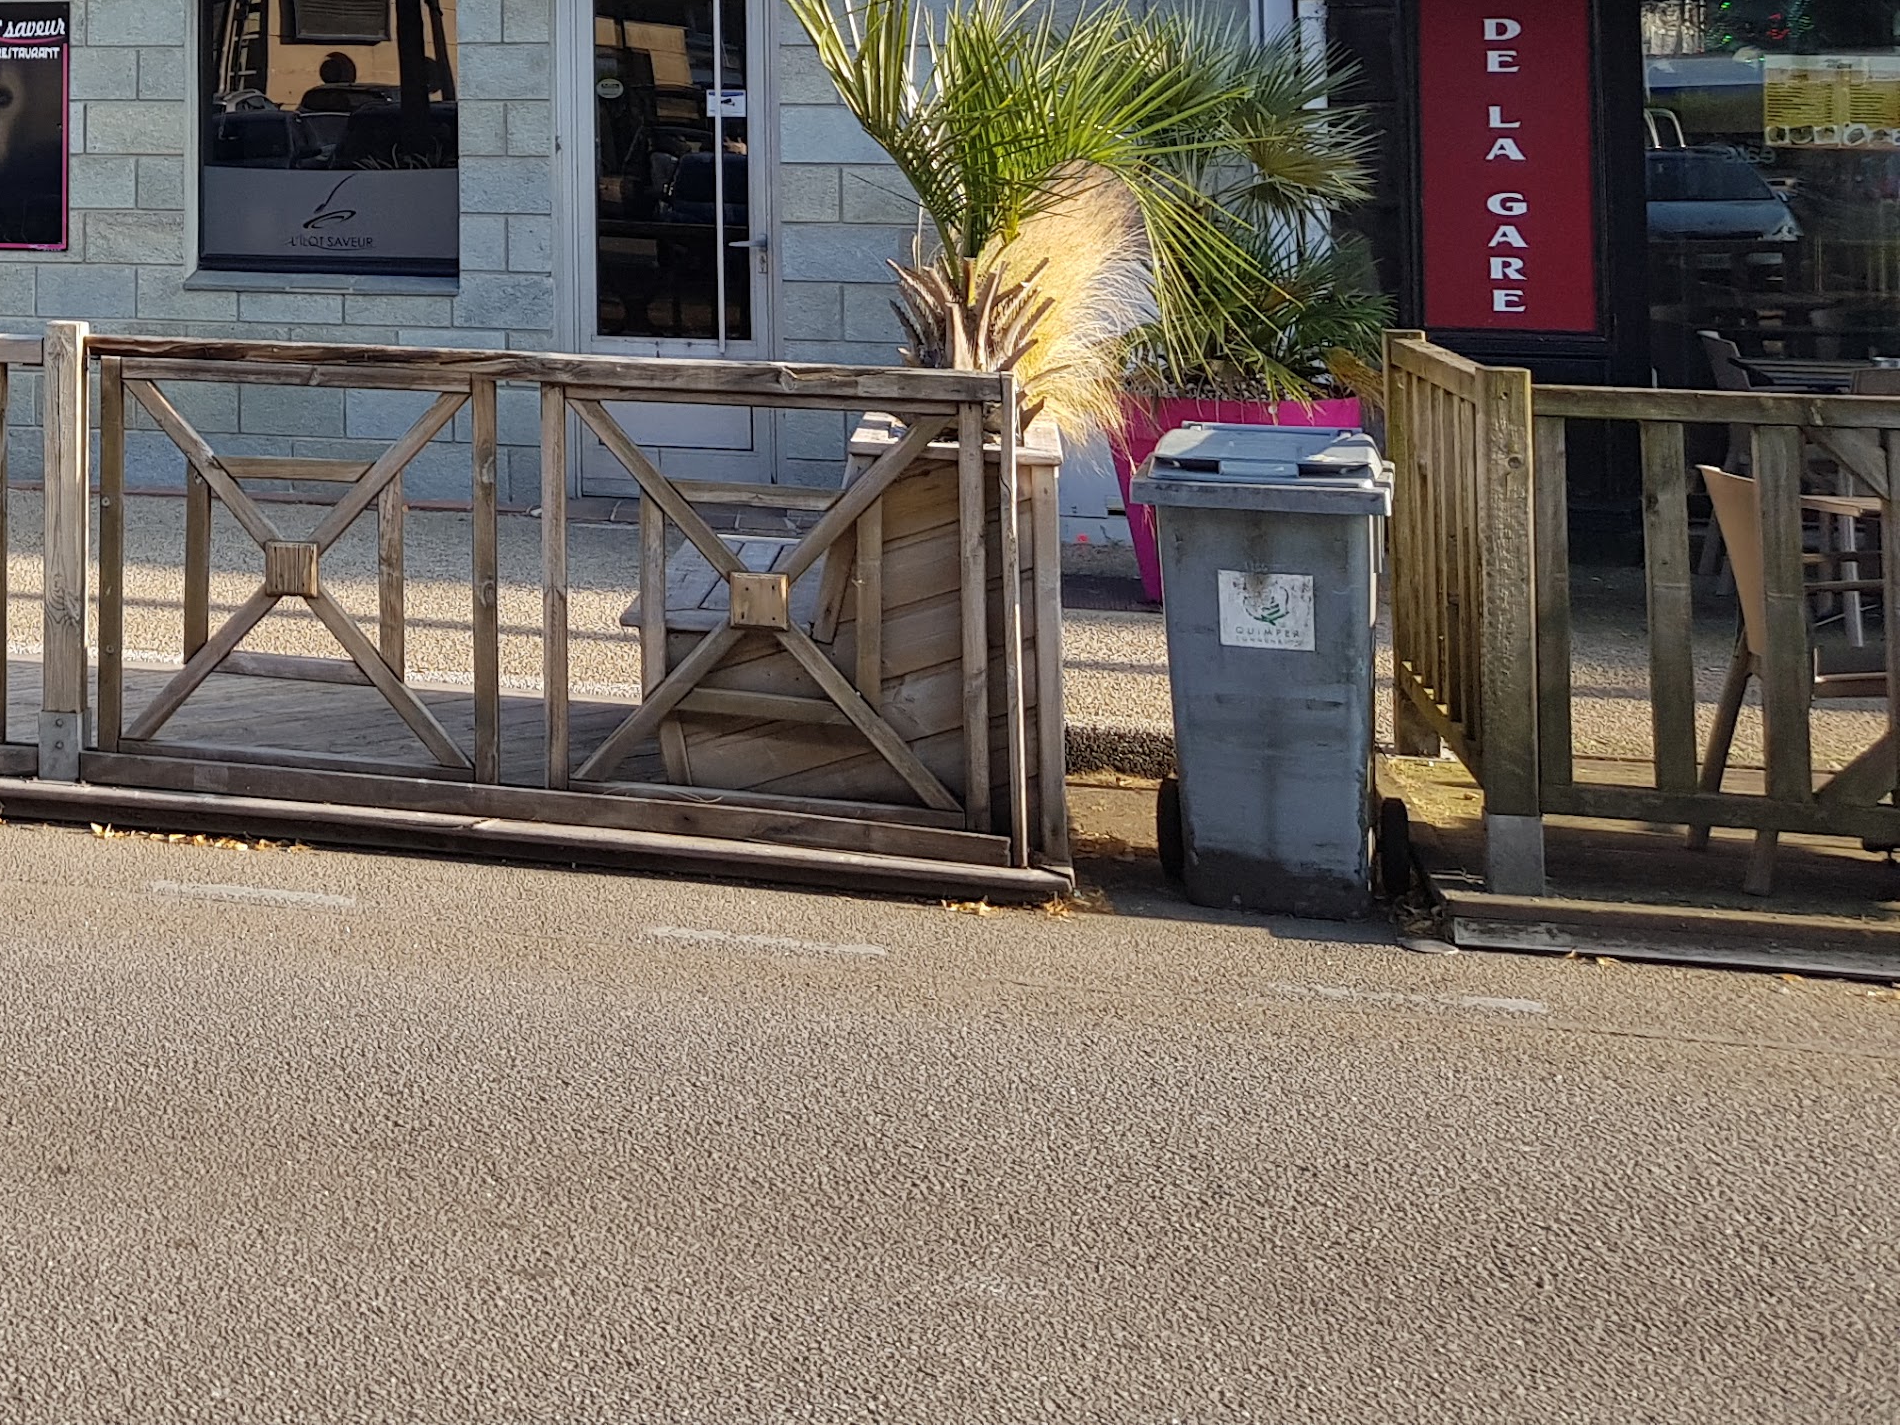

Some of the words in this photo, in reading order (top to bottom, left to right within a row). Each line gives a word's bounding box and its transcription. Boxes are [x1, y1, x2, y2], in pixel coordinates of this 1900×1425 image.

[3, 18, 66, 38] saveur
[1482, 18, 1523, 74] DE
[1486, 105, 1527, 162] LA
[326, 236, 373, 248] SAVEUR
[1486, 192, 1529, 314] GARE
[1235, 626, 1300, 638] QUIMPER
